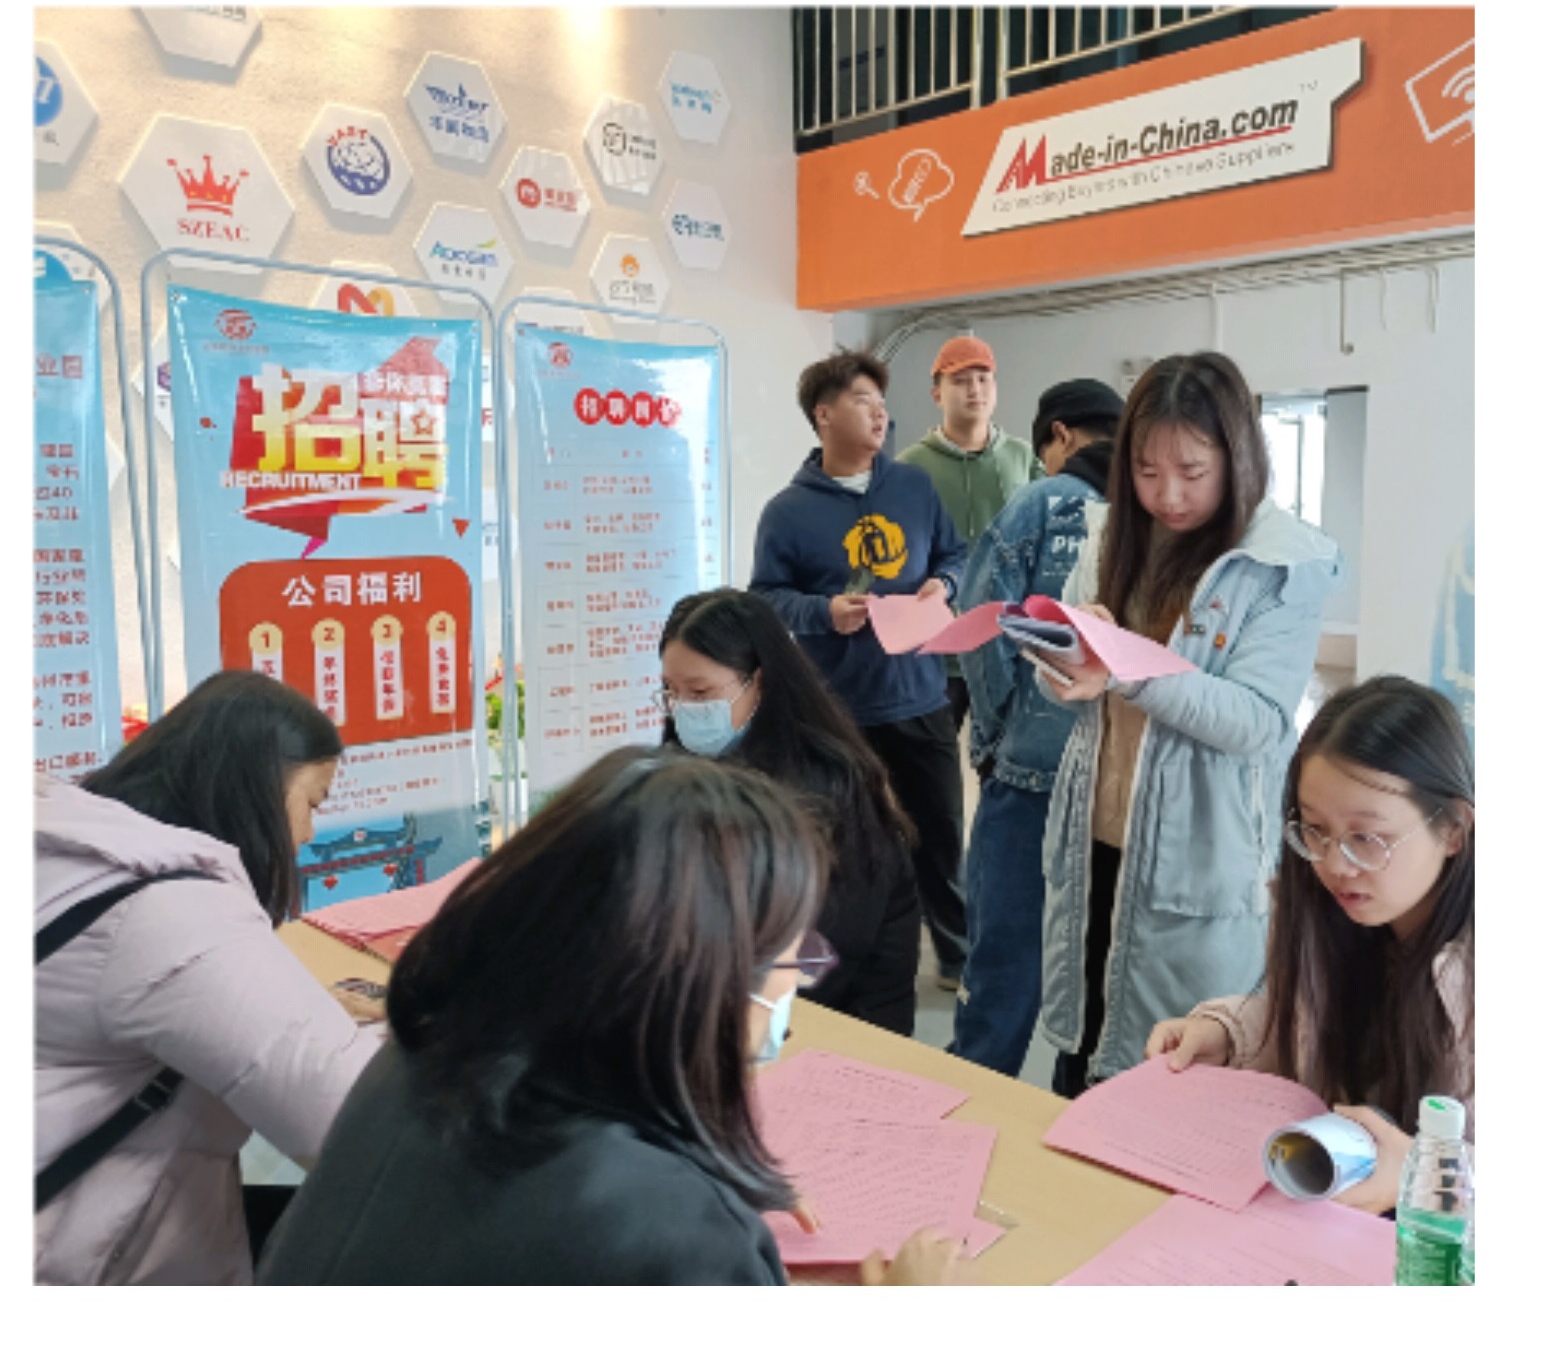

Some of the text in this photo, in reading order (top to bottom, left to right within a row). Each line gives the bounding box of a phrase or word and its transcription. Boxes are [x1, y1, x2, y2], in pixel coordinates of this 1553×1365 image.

[995, 98, 1299, 194] Made-in-China.com
[175, 218, 252, 245] SZEAC
[249, 361, 448, 490] 招聘
[220, 471, 362, 491] RECRUITMENT
[281, 570, 422, 608] 公司福利
[323, 627, 336, 642] 2
[382, 624, 392, 639] 3
[436, 619, 447, 634] 4
[261, 631, 271, 649] 1
